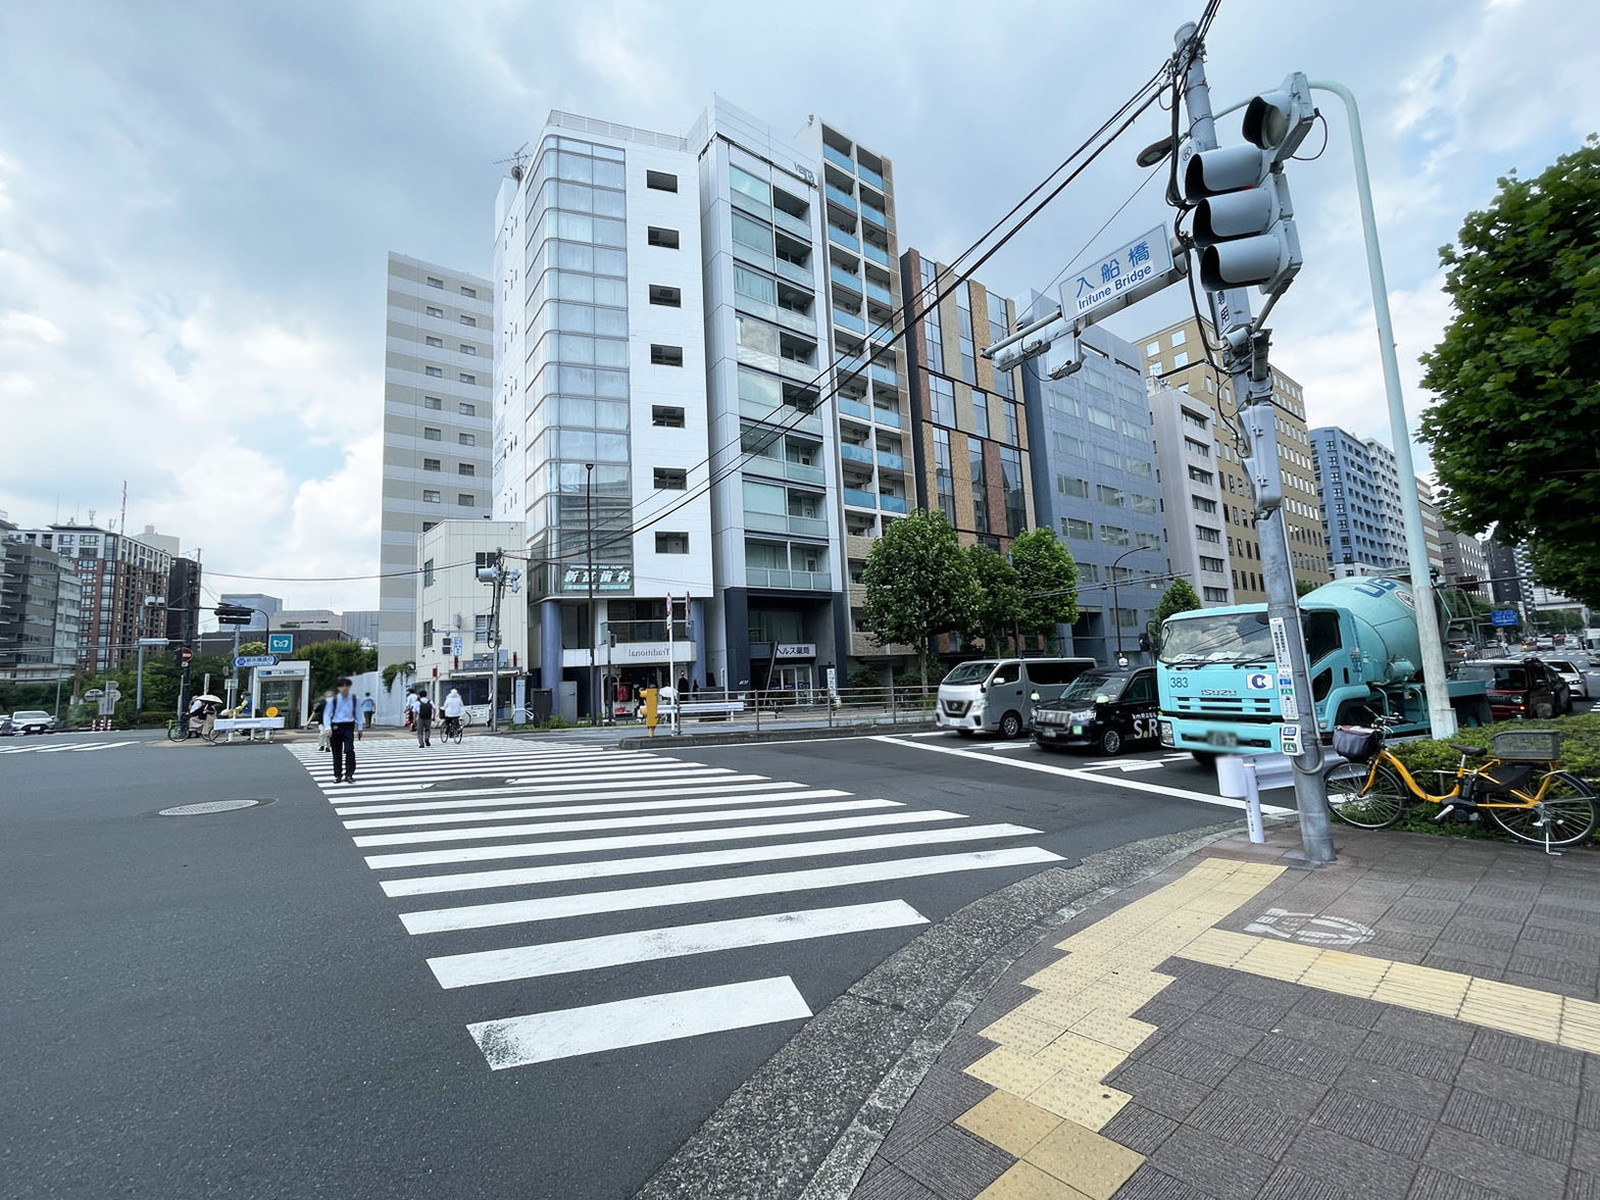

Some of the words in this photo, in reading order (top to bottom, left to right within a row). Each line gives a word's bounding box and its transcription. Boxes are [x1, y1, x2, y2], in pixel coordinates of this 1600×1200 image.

[1076, 241, 1150, 298] 入船橋
[1078, 287, 1111, 310] Irifune
[1114, 265, 1152, 290] Bridge
[1170, 677, 1189, 688] 383
